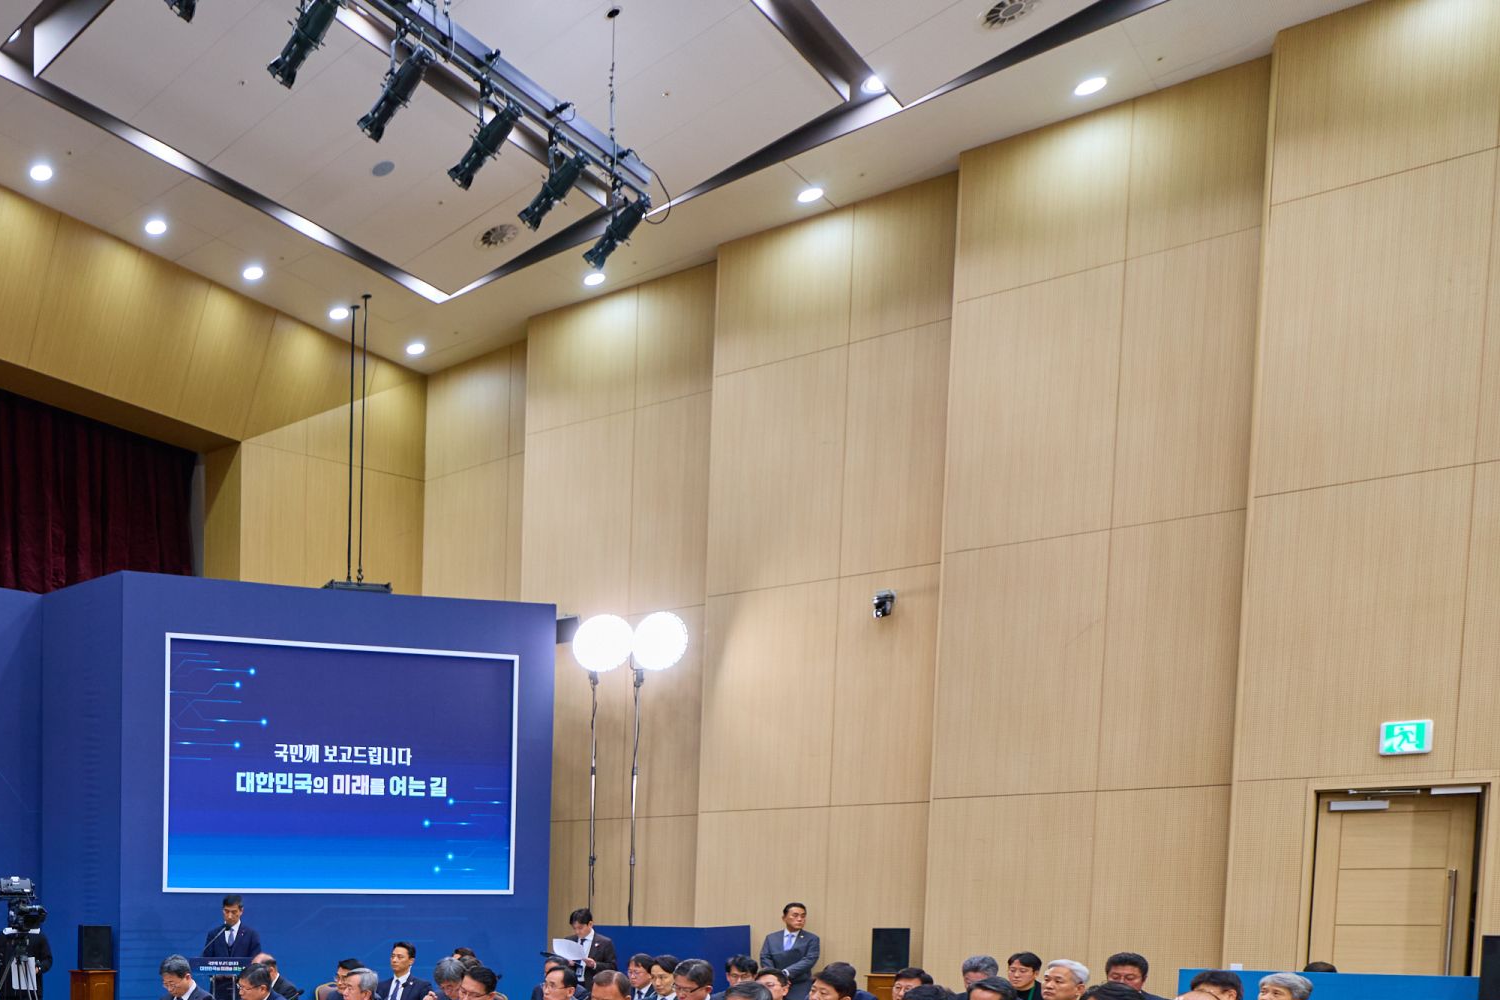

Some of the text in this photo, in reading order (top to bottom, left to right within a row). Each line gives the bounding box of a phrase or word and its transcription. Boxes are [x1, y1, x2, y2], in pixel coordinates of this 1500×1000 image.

[274, 743, 412, 767] 국민께 보고드립니다
[236, 771, 447, 798] 대한민국의 미래를 여는 길
